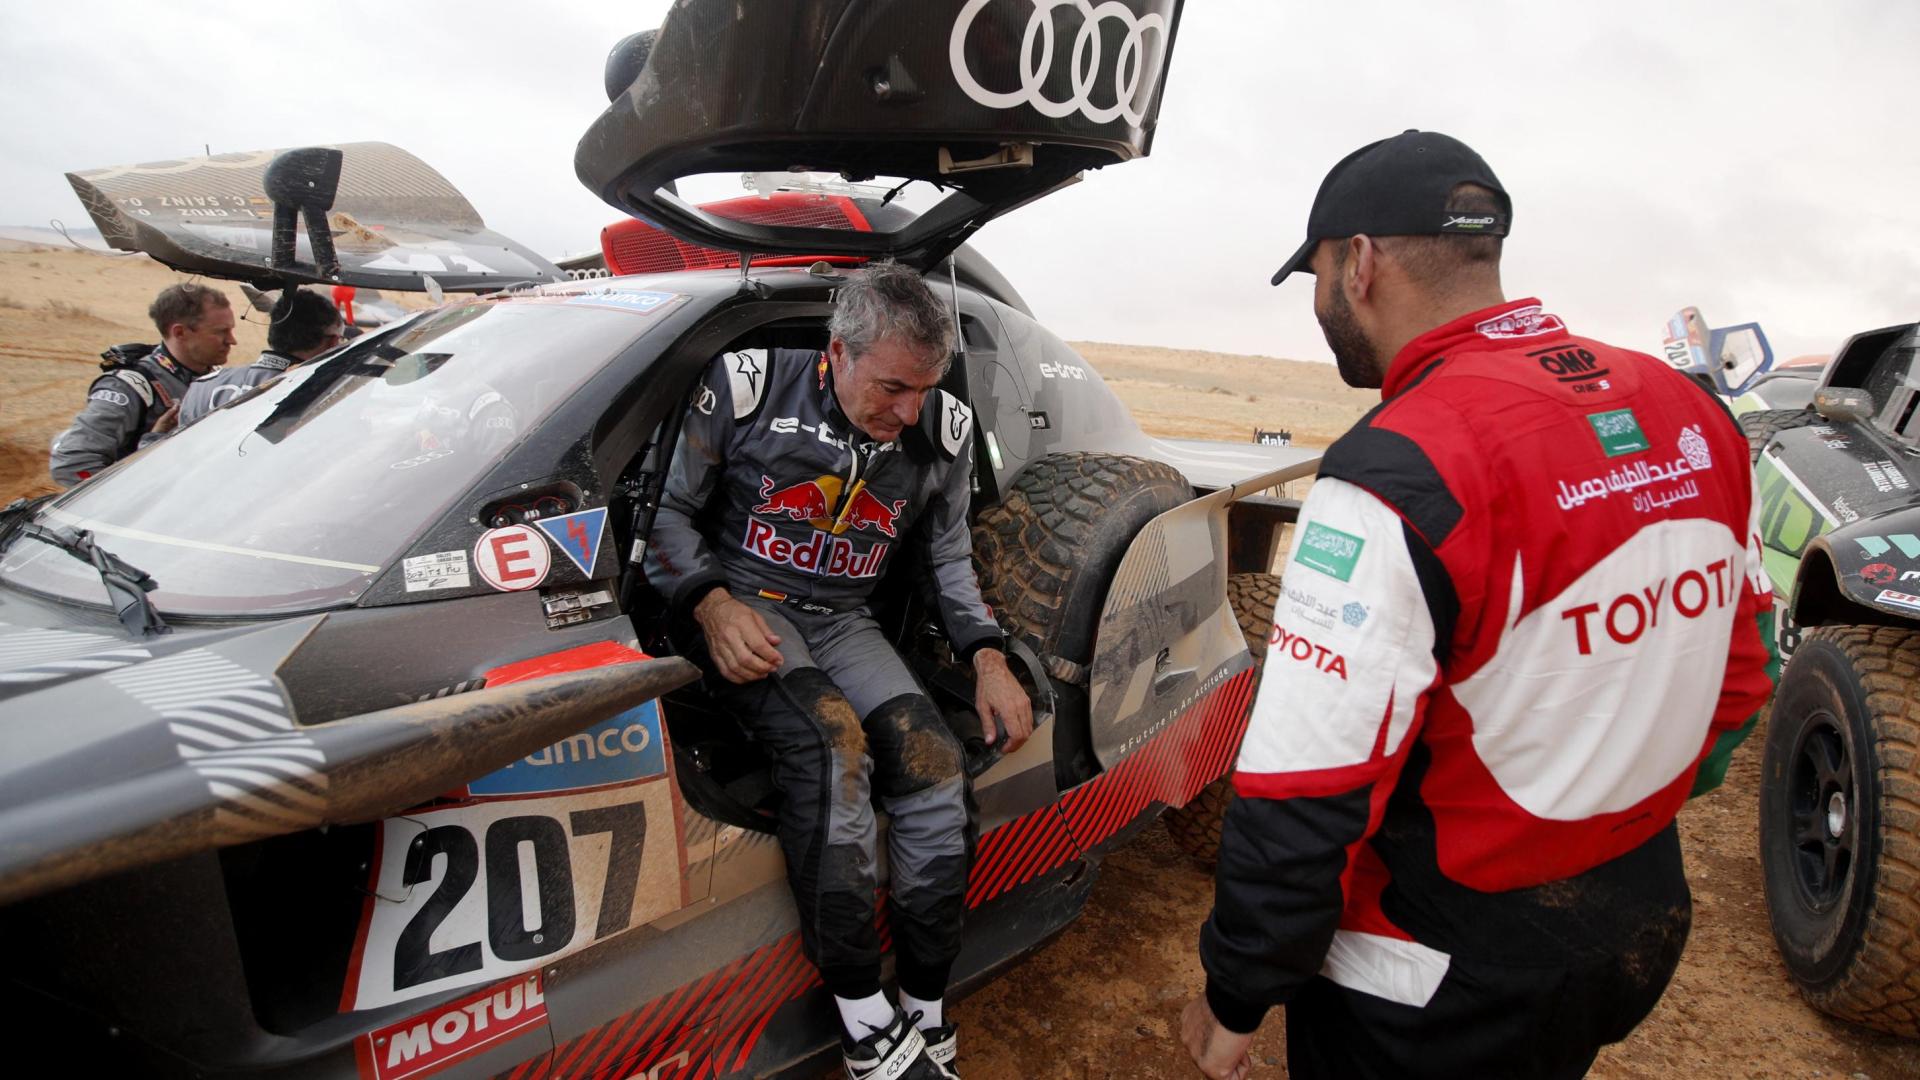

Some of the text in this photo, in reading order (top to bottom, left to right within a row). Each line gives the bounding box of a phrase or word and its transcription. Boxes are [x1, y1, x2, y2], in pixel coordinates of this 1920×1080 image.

[161, 196, 220, 207] SAINZ
[177, 208, 228, 217] CRUZ
[1039, 360, 1088, 382] e-tron
[1539, 348, 1597, 376] OMP
[490, 532, 537, 583] E
[742, 515, 827, 574] Red
[826, 536, 890, 579] Bull
[1269, 623, 1348, 682] OYOTA
[1119, 717, 1166, 755] #Future
[1180, 696, 1192, 711] An
[1194, 666, 1229, 698] Attitude
[506, 724, 650, 769] amco
[393, 800, 648, 992] 207
[387, 977, 545, 1070] MOTUL
